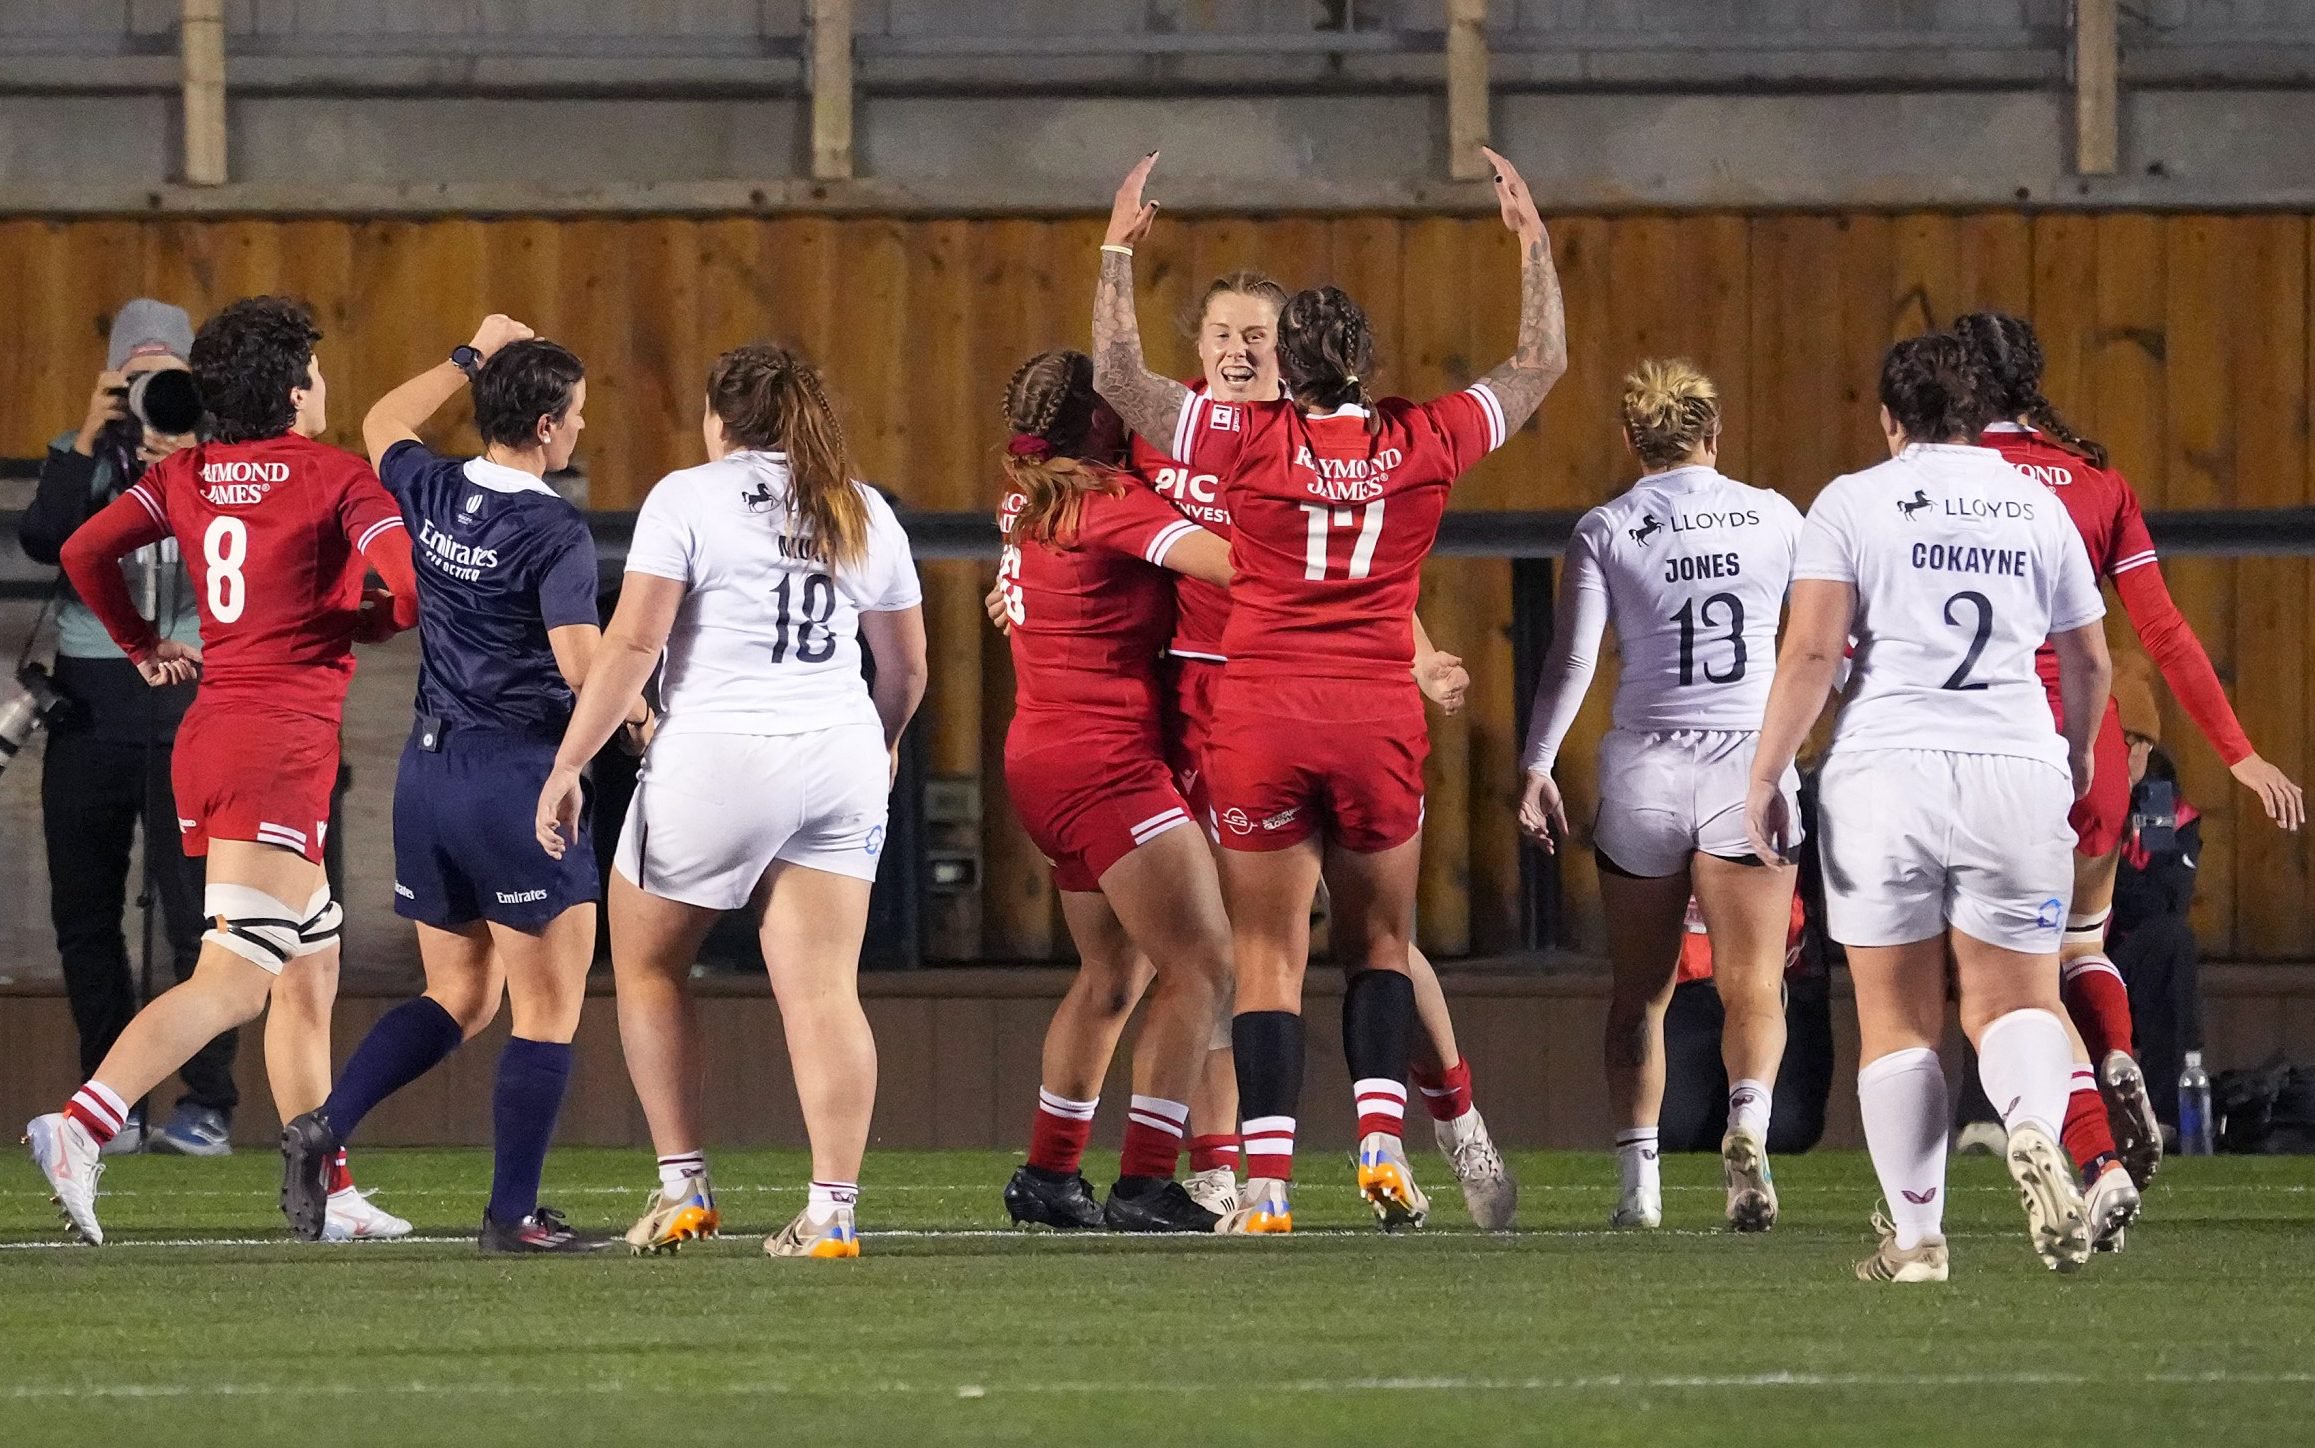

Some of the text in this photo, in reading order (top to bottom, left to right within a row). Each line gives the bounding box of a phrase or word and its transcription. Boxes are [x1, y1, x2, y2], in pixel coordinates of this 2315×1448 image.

[1294, 446, 1402, 478] RYMOND
[1176, 501, 1230, 525] NVEST
[1671, 511, 1760, 532] LLOYDS
[1945, 498, 2034, 520] LLOYDS
[420, 518, 498, 568] Emirates
[1300, 498, 1385, 580] 17
[204, 516, 247, 623] 8
[1665, 553, 1740, 583] JONES
[1912, 543, 2026, 577] COKAYNE
[769, 573, 836, 663] 18
[1669, 593, 1747, 685] 13
[1942, 591, 1993, 689] 2
[496, 889, 548, 904] Emirates
